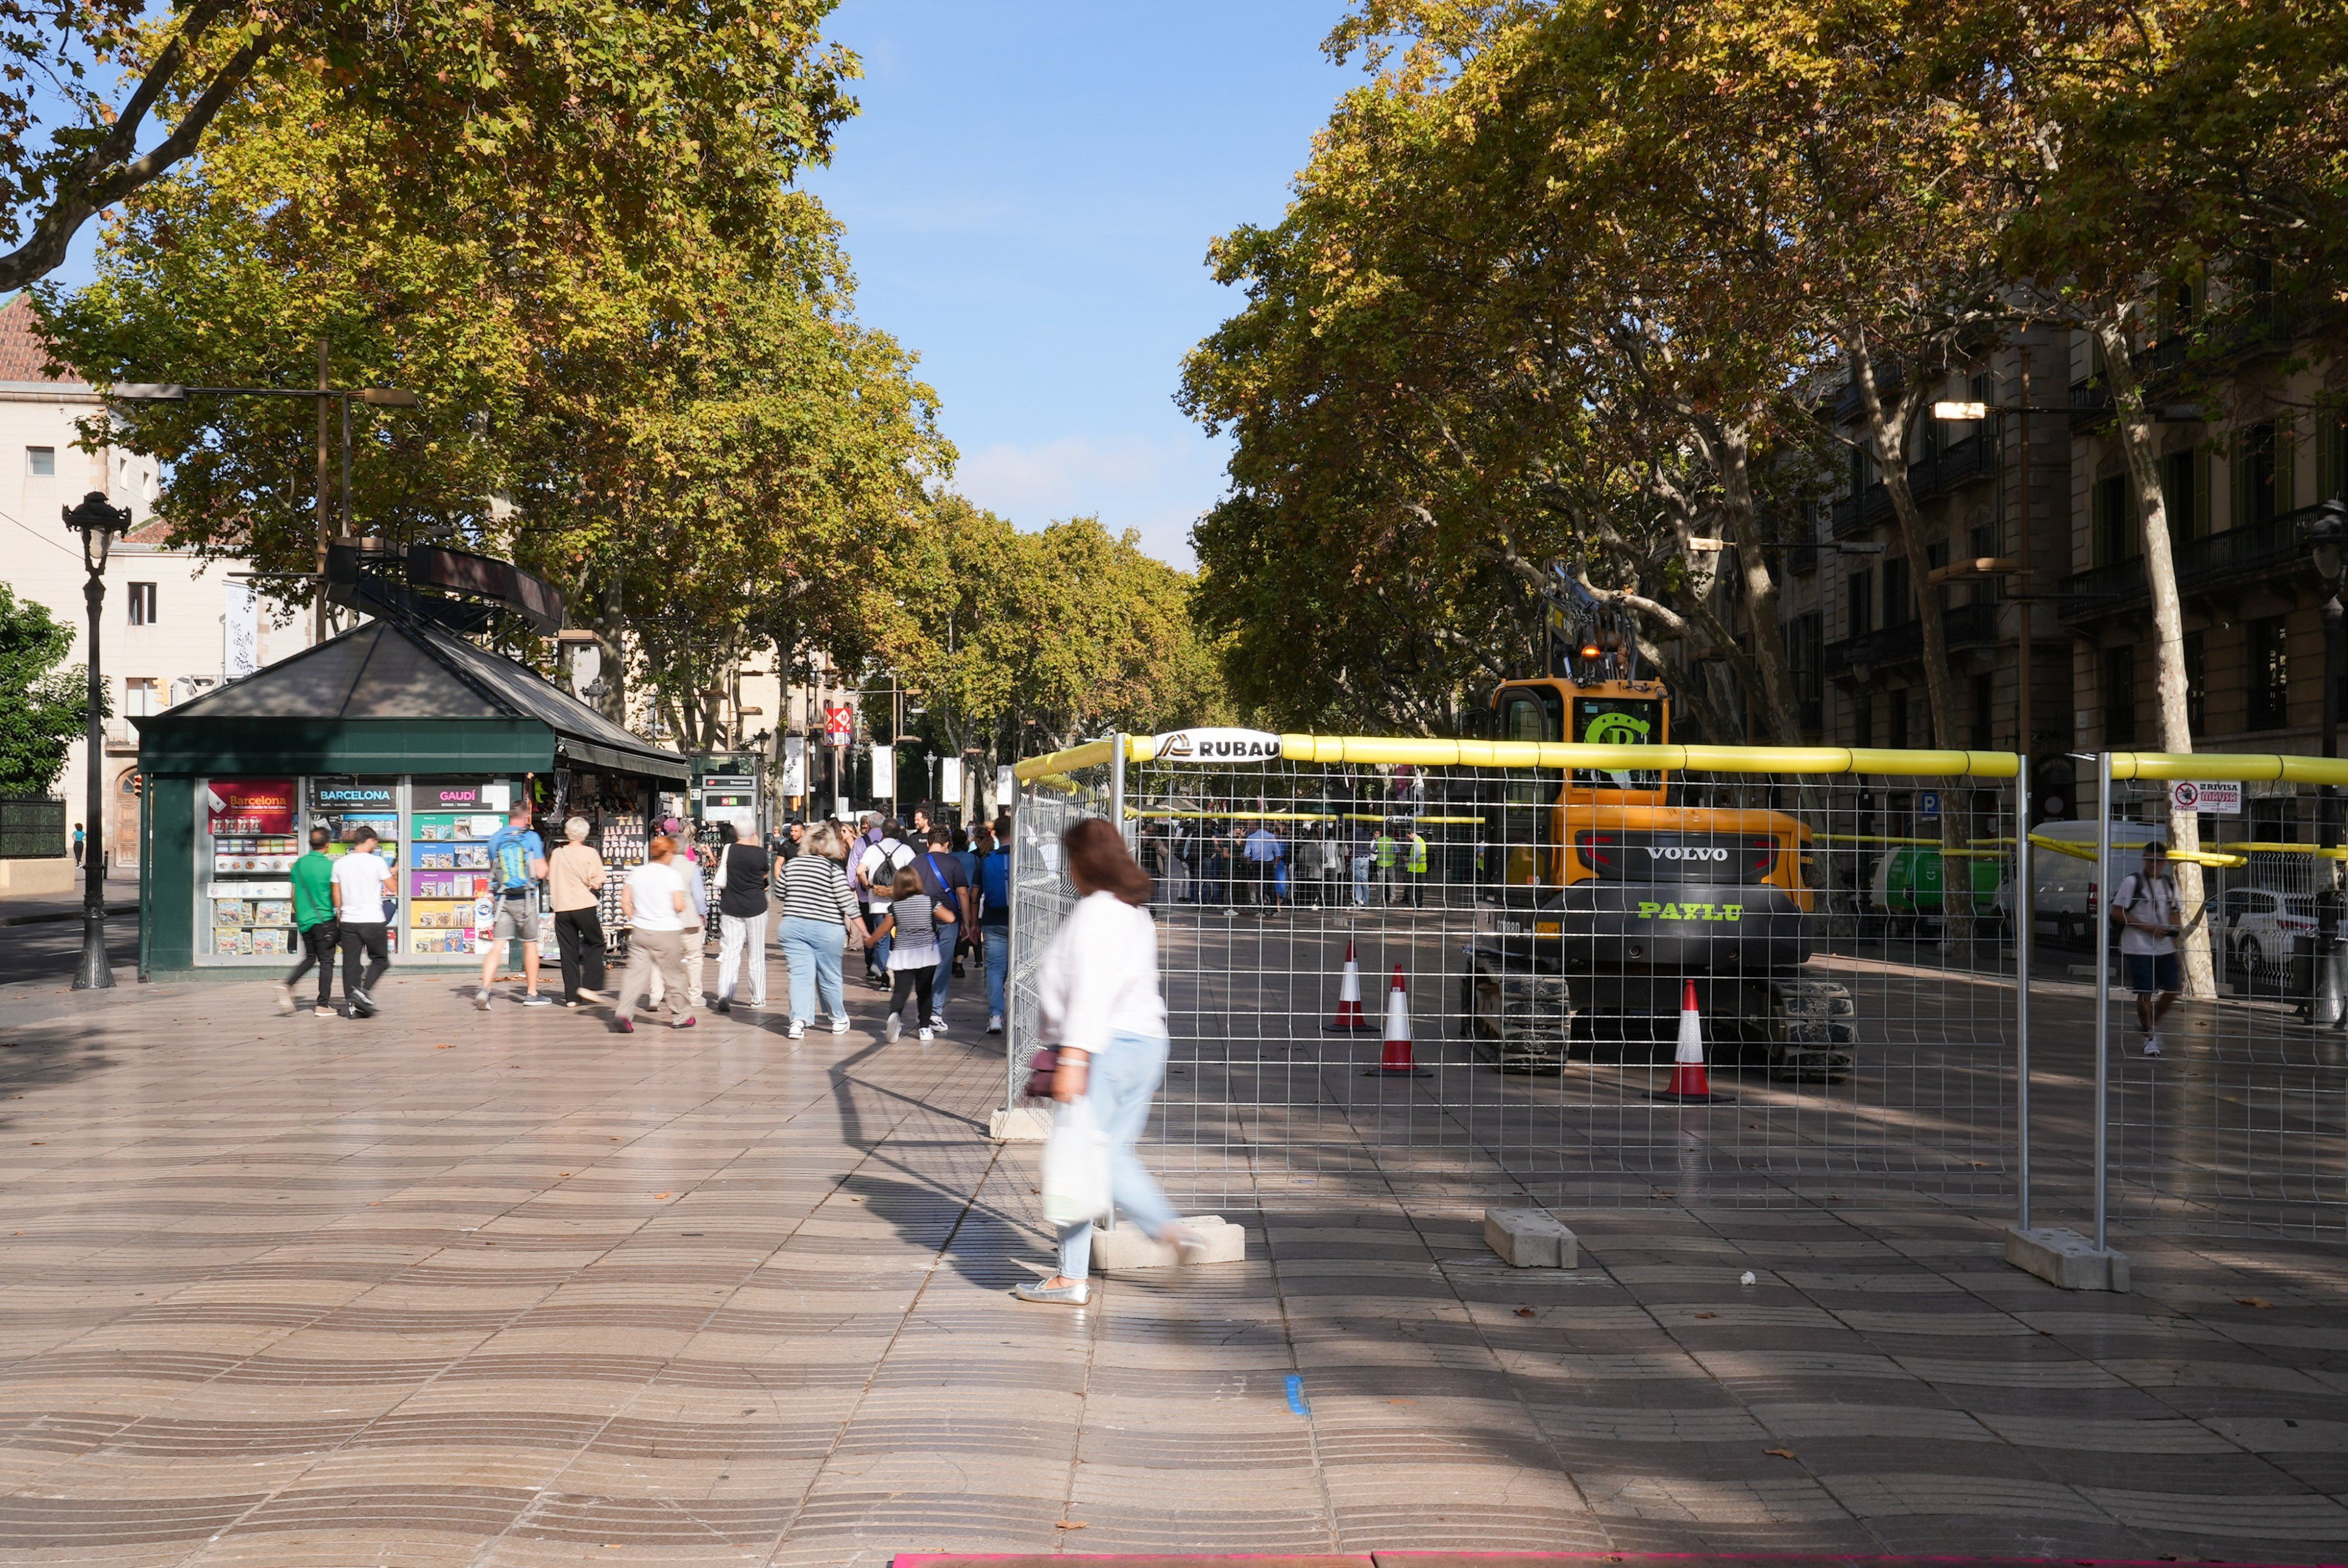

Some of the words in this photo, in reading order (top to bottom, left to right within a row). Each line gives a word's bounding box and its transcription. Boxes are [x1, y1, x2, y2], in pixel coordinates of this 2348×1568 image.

[1199, 741, 1280, 756] RUBAU
[230, 795, 286, 805] Barcelona
[320, 790, 390, 800] BARCELONA
[440, 789, 476, 801] GAUDÍ
[1924, 796, 1935, 812] P
[1644, 846, 1728, 861] VOLVO
